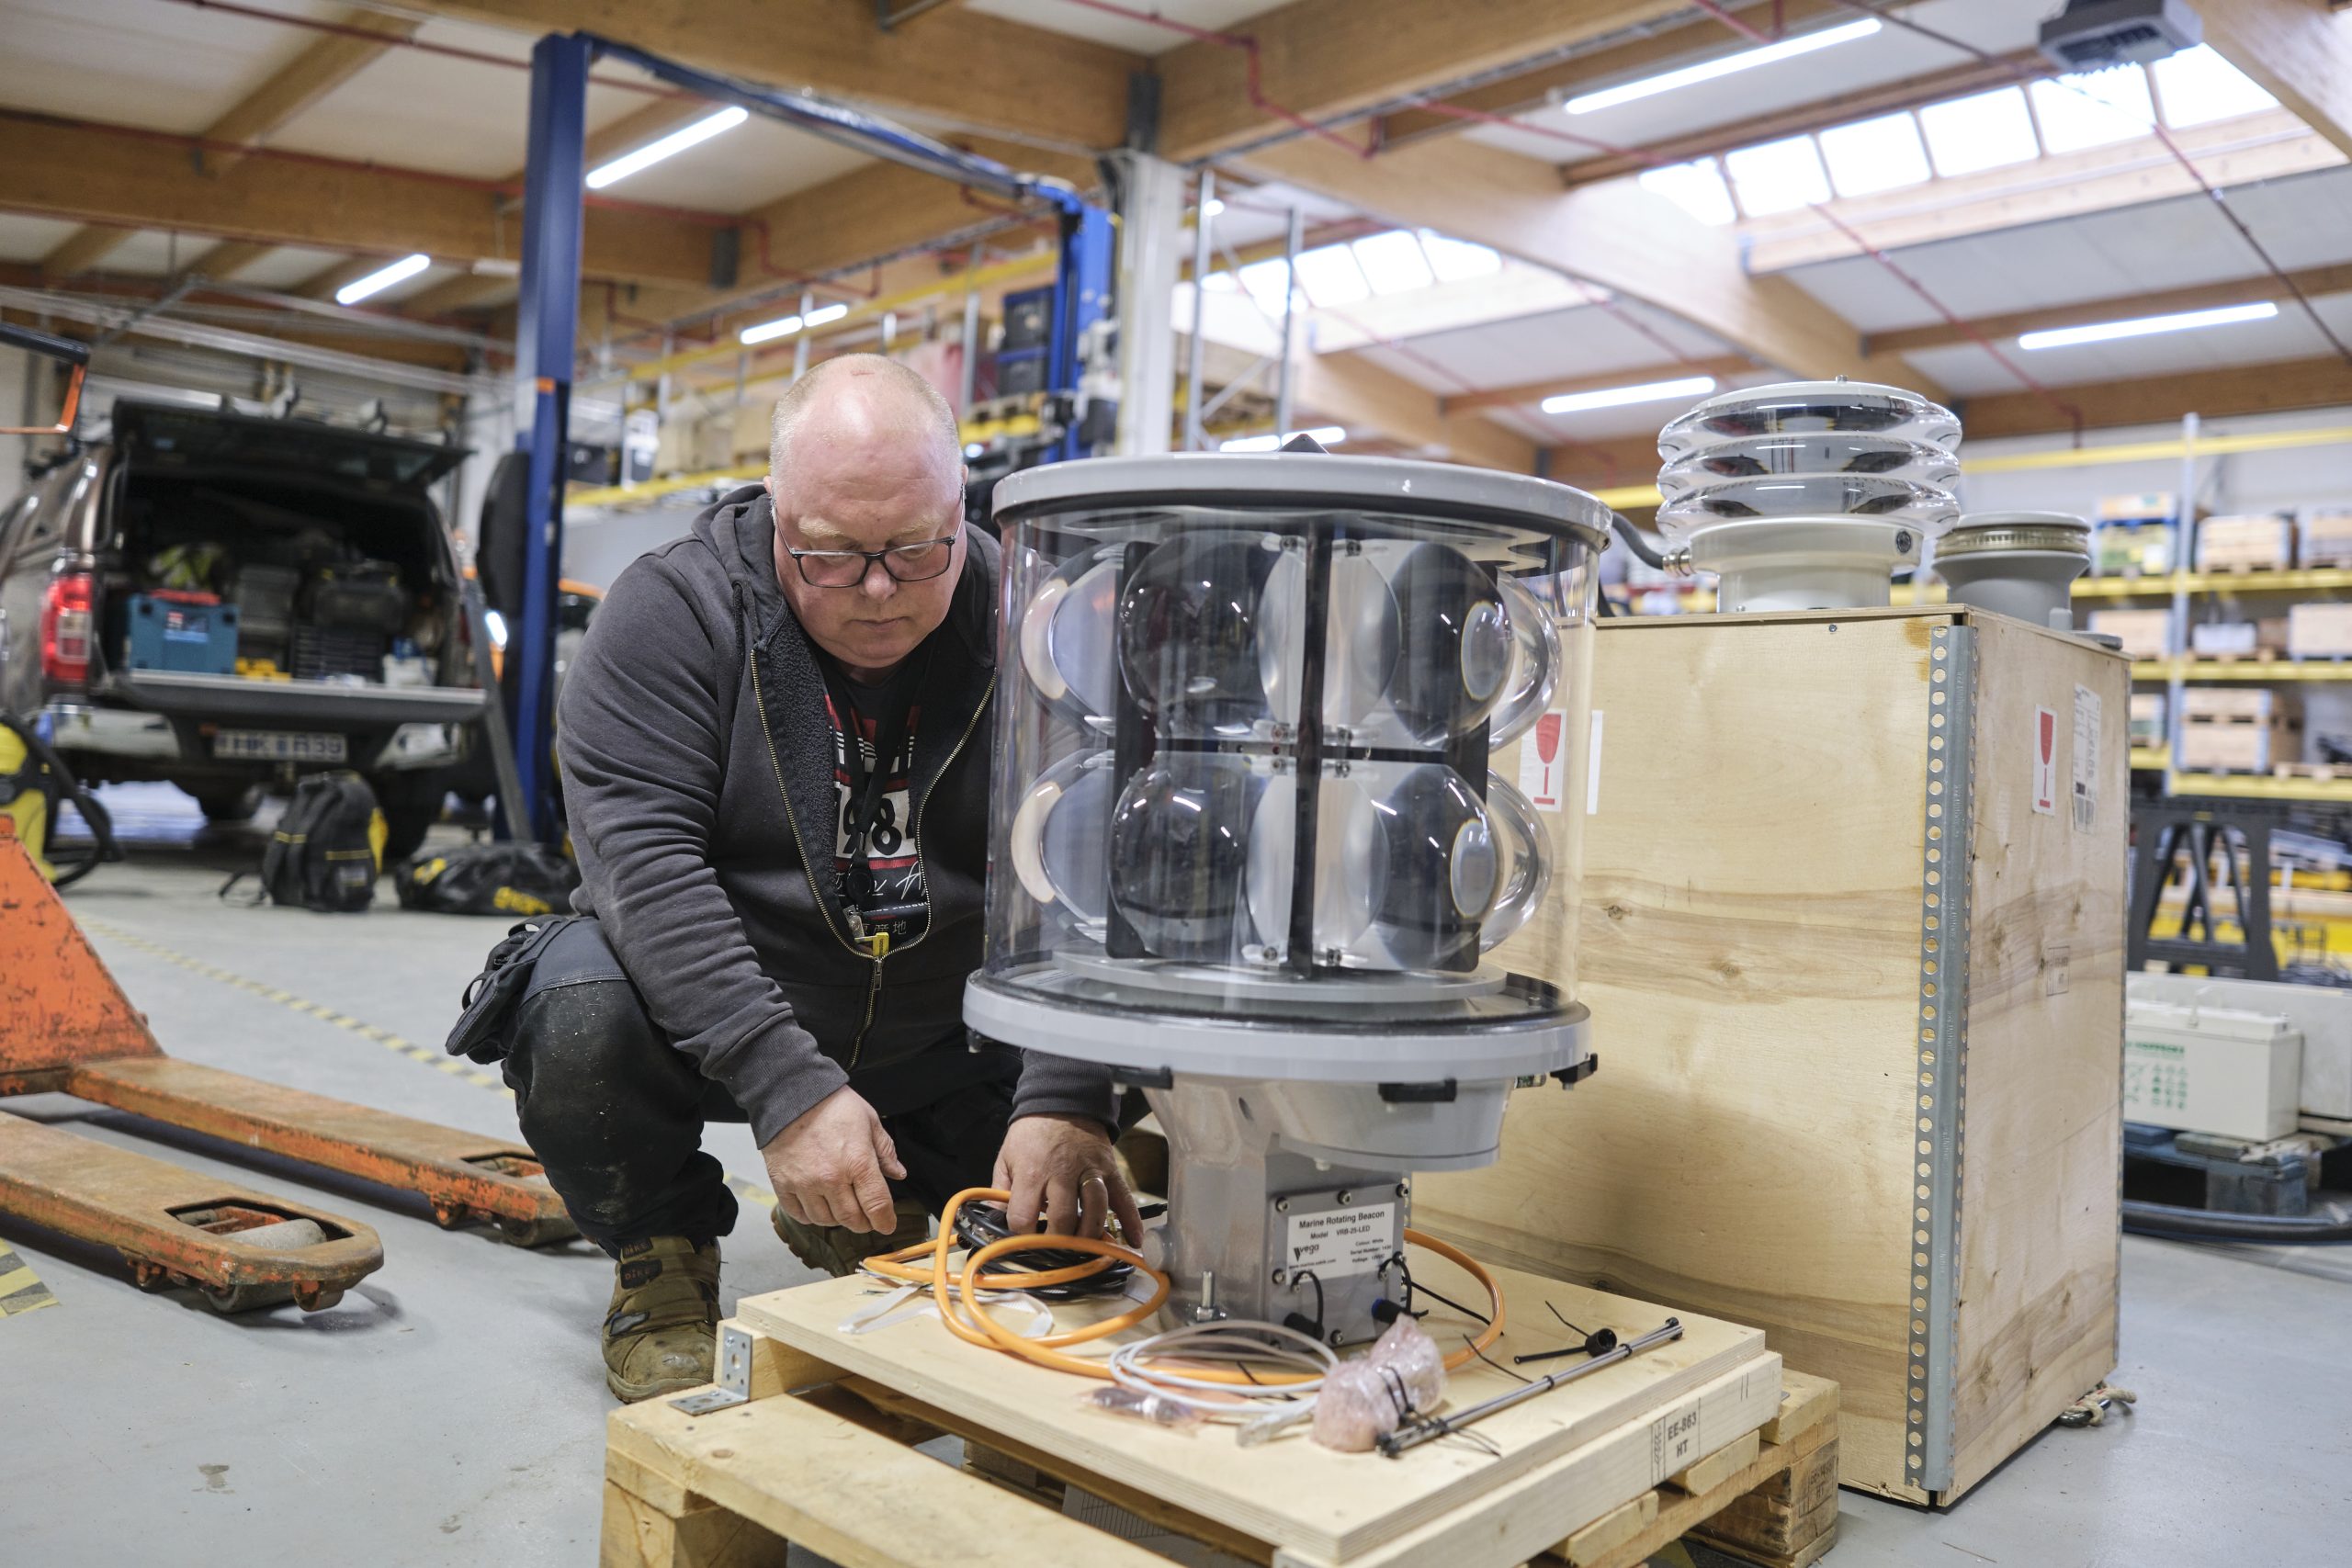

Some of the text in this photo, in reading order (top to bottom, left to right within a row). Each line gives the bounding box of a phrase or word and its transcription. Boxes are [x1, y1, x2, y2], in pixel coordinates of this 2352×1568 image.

[1299, 1211, 1385, 1229] Marine Rotating Beacon
[1336, 1225, 1371, 1235] VRB-25-LED
[1299, 1244, 1319, 1255] vega
[1668, 1411, 1697, 1441] EE-863
[1677, 1438, 1688, 1459] HT
